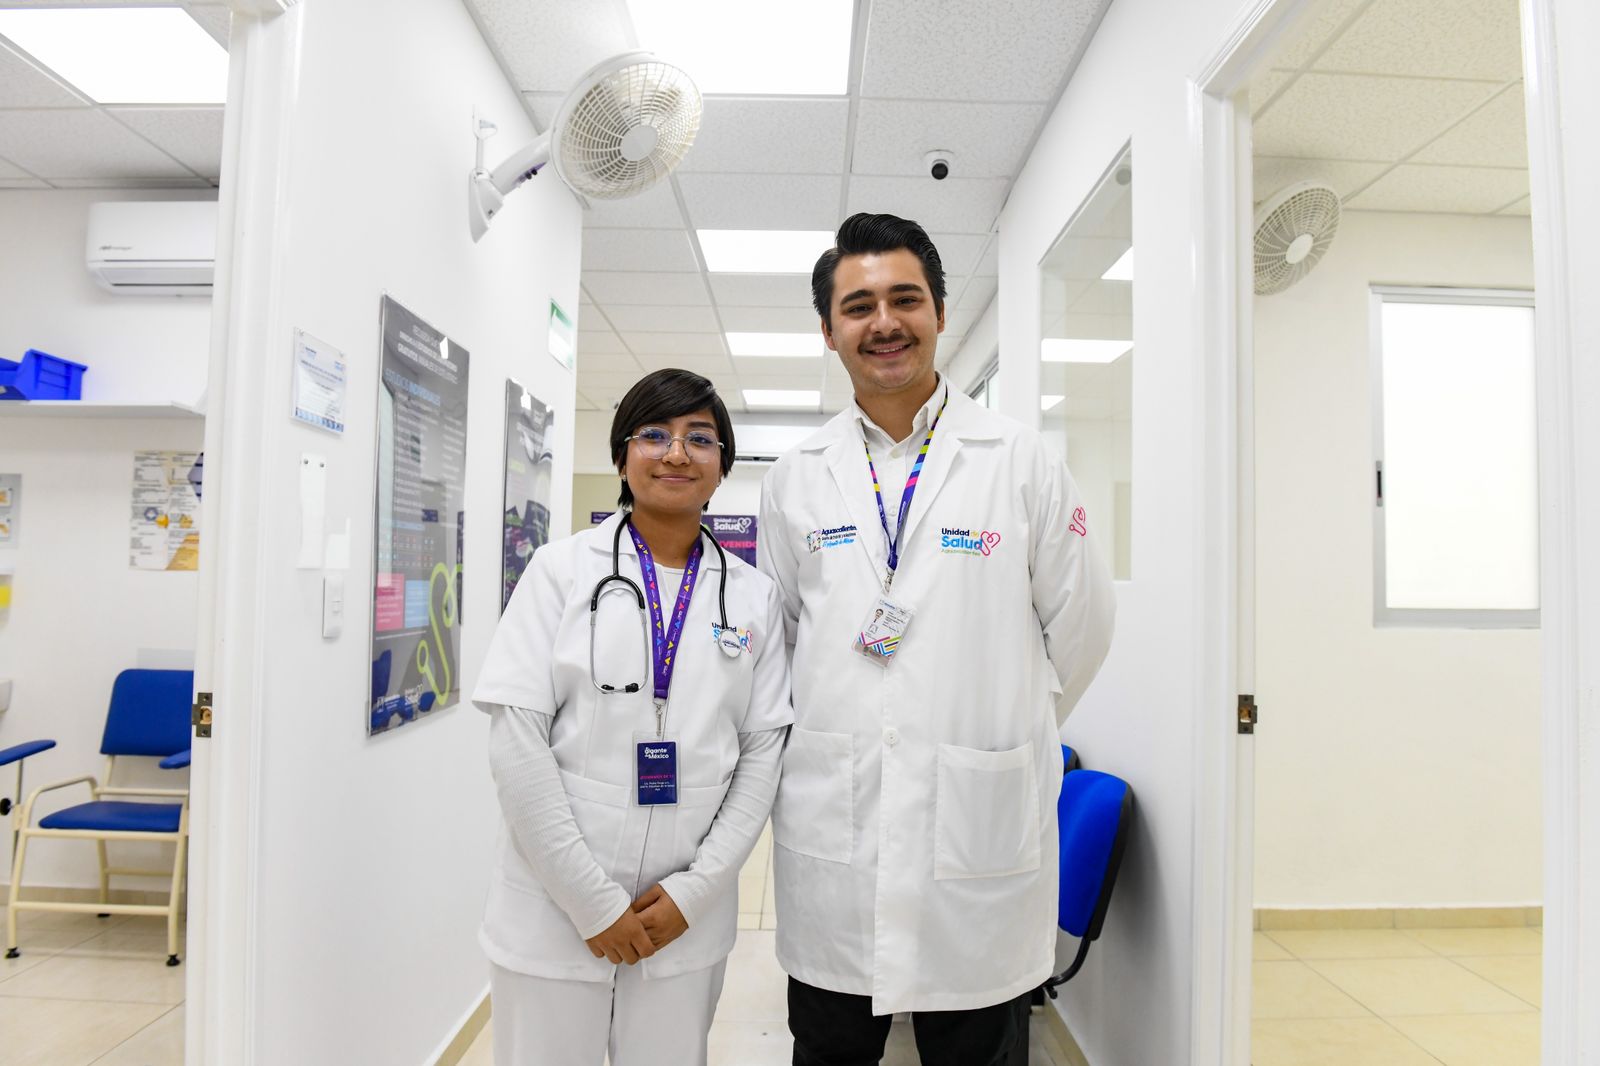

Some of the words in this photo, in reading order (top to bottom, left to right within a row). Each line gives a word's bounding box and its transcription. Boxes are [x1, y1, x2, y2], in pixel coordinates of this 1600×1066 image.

[713, 522, 740, 531] Salud
[941, 528, 970, 537] Unidad
[941, 536, 983, 550] Salud
